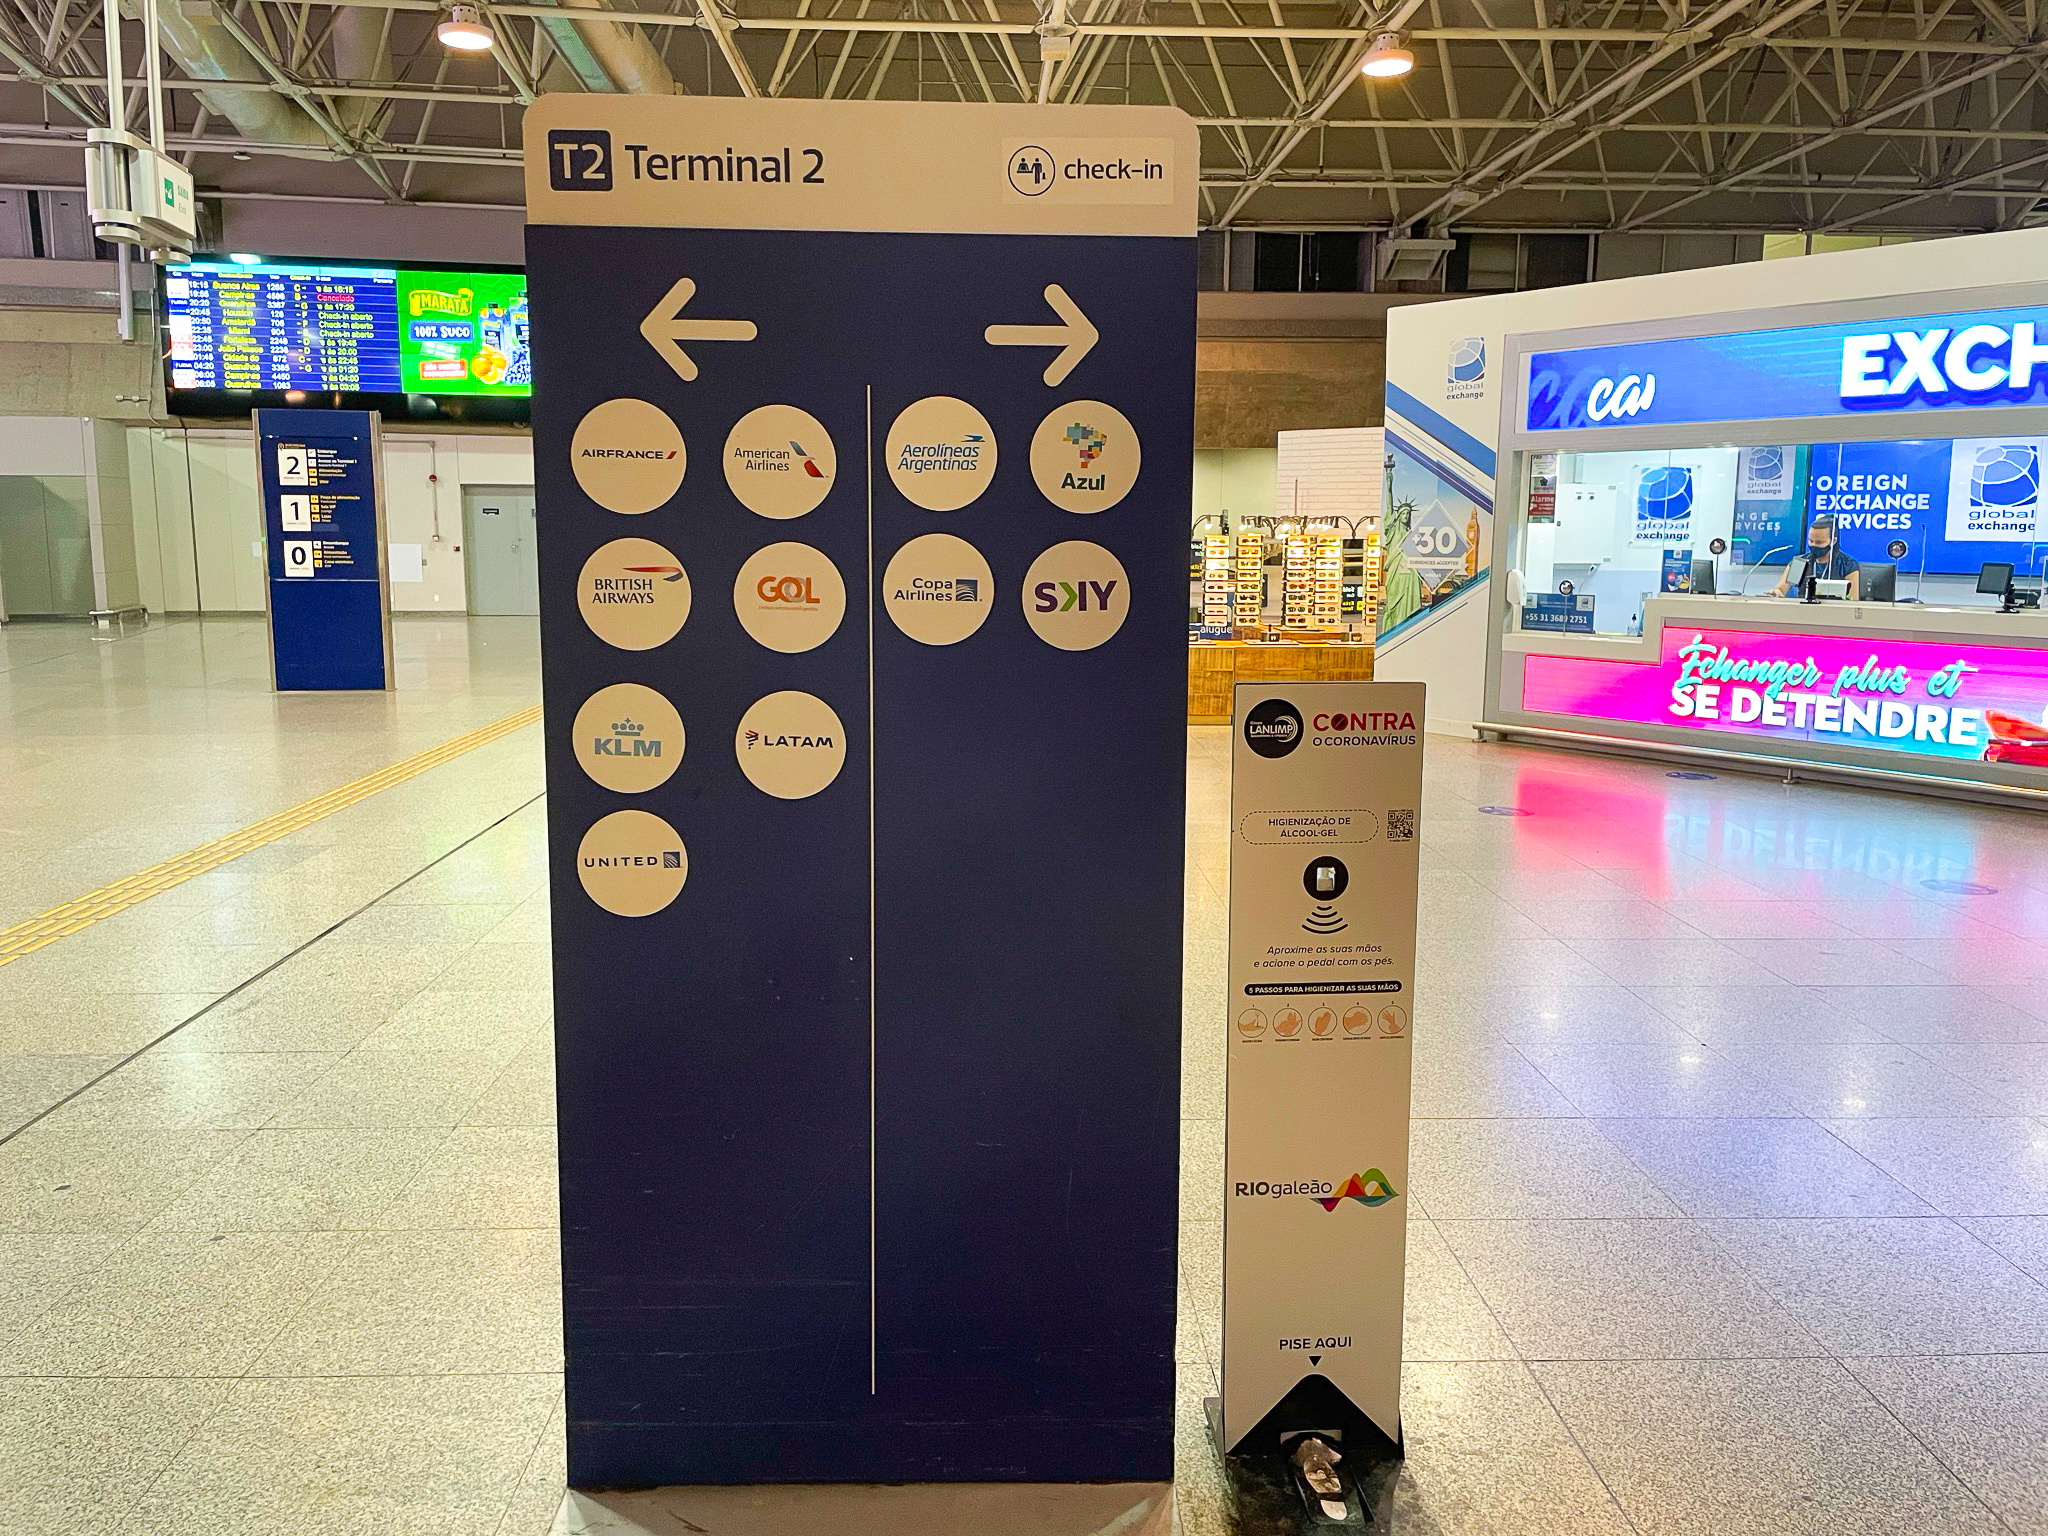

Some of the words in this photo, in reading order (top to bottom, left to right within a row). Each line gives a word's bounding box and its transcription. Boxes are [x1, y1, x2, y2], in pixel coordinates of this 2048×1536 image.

[554, 144, 606, 179] T2
[625, 145, 791, 183] Terminal
[802, 149, 825, 184] 2
[1064, 158, 1163, 180] check-in
[241, 282, 260, 290] Aires
[219, 291, 255, 300] Campinas
[317, 294, 355, 302] Cancelado
[189, 299, 210, 307] 20:20
[223, 309, 253, 317] Houston
[350, 313, 373, 321] aberto
[351, 322, 374, 330] aberto
[414, 326, 438, 338] 100%
[441, 325, 470, 339] SUCO
[351, 331, 375, 339] aberto
[1840, 322, 2048, 397] EXCH
[193, 362, 215, 370] 04:20
[1447, 382, 1484, 393] global
[1446, 391, 1484, 400] exchange
[581, 449, 664, 460] AIRFRANCE
[734, 447, 790, 460] American
[901, 443, 980, 458] Aerolíneas
[286, 456, 301, 475] 2
[745, 460, 790, 471] Airlines
[897, 458, 977, 474] Argentinas
[1061, 473, 1106, 491] Azul
[1810, 474, 1908, 491] OREIGN
[1530, 495, 1554, 503] Alarme
[1816, 493, 1930, 510] EXCHANGE
[290, 502, 299, 521] 1
[1969, 509, 2035, 521] global
[1637, 521, 1690, 531] global
[1816, 513, 1912, 530] RVICES
[1967, 521, 2035, 532] exchange
[1636, 531, 1690, 541] exchange
[291, 546, 306, 565] 0
[594, 579, 653, 591] BRITISH
[757, 576, 820, 603] GOL
[912, 578, 953, 591] Copa
[592, 593, 655, 604] AIRWAYS
[894, 590, 952, 602] Airlines
[1525, 613, 1539, 621] +55
[1540, 614, 1549, 622] 31
[1569, 616, 1588, 624] 2751
[1831, 654, 1911, 698] plus
[1927, 659, 1979, 699] et
[1668, 684, 1721, 719] SE
[1313, 712, 1416, 732] CONTRA
[1250, 725, 1294, 734] LANLIMP
[764, 735, 834, 748] LATAM
[1312, 736, 1323, 747] O
[1324, 733, 1416, 746] CORONAVÍRUS
[594, 738, 661, 757] KLM
[1268, 816, 1336, 827] HIGIENIZAÇÃO
[1338, 817, 1351, 825] DE
[1280, 827, 1339, 838] ÁLCOOL-GEL
[584, 856, 658, 868] UNITED
[1267, 945, 1313, 956] Aproxime
[1315, 946, 1327, 954] as
[1330, 945, 1353, 954] suas
[1355, 944, 1382, 953] mãos
[1253, 960, 1260, 968] e
[1262, 959, 1295, 968] acione
[1306, 957, 1335, 969] pedal
[1337, 959, 1358, 967] com
[1360, 958, 1372, 966] os
[1374, 955, 1395, 967] pés.
[1254, 986, 1284, 994] PASSOS
[1305, 985, 1345, 993] HIGIENIZAR
[1357, 984, 1377, 992] SUAS
[1377, 982, 1399, 991] MÃOS
[1235, 1180, 1333, 1199] RIOgaleão
[1279, 1338, 1311, 1350] PISE
[1315, 1337, 1352, 1349] AQUI
